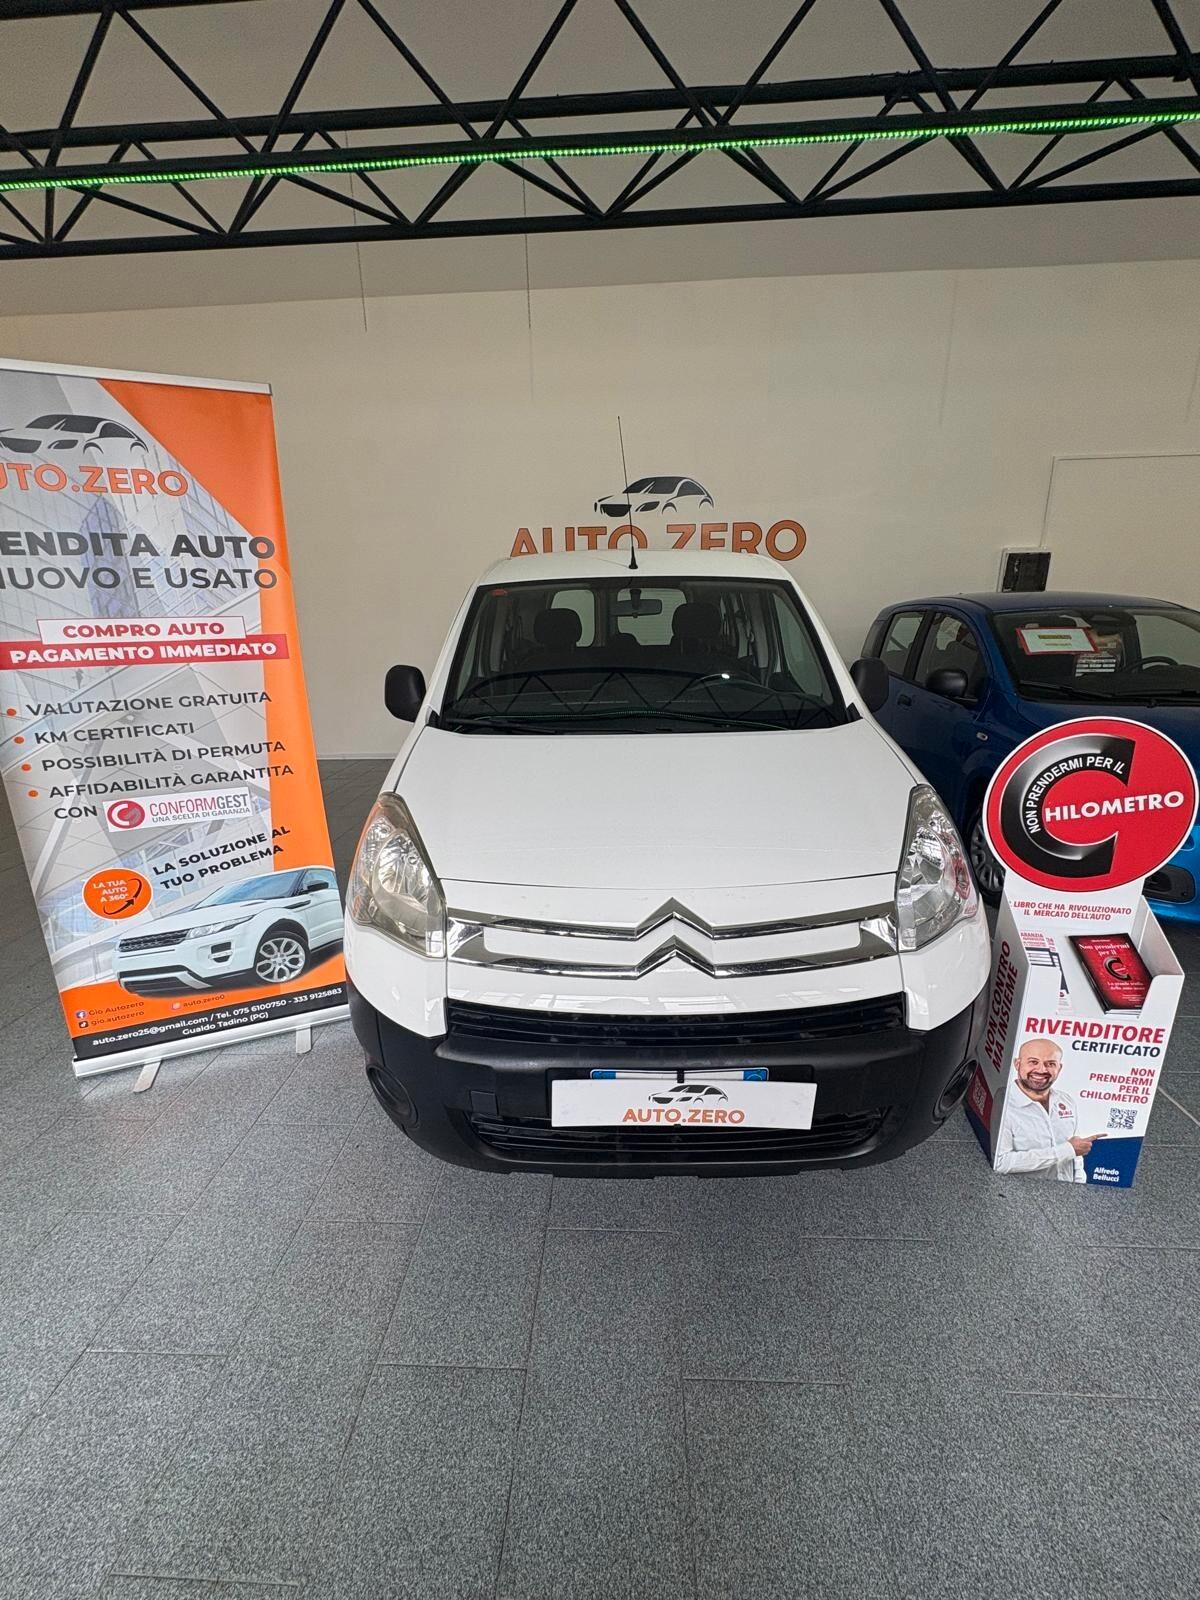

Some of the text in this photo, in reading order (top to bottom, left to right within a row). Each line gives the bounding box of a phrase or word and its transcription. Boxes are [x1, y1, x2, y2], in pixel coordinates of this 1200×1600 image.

[170, 534, 276, 559] AUTO
[0, 566, 278, 590] UOVO E USATO
[63, 622, 225, 638] COMPRO AUTO
[9, 642, 277, 664] PAGAMENTO IMMEDIATO
[26, 691, 273, 717] VALUTAZIONE GRATUITA
[34, 722, 195, 745] KM CERTIFICATI
[42, 741, 286, 772] POSSIBILITÀ DI PERMUTA
[49, 764, 294, 799] AFFIDABILITÀ GARANTITA
[1025, 756, 1125, 834] NON PRENDERMI PER IL
[54, 805, 98, 819] CON
[150, 793, 249, 817] CONFORMGEST
[152, 807, 251, 823] UNA SCELTA DI GARANZIA
[152, 826, 291, 876] LA SOLUZIONE AL
[160, 844, 284, 890] TUO PROBLEMA
[93, 881, 107, 889] LA
[102, 886, 127, 895] AUTO
[1013, 901, 1132, 915] LIBRO CHE HA RIVOLUZIONATO
[1033, 910, 1070, 919] MERCATO
[985, 940, 1011, 1059] NON CONTRO
[216, 1011, 231, 1019] Tel.
[233, 1007, 250, 1016] 075
[251, 1000, 287, 1012] 6100750
[992, 963, 1019, 1073] MA INSIEME
[182, 1024, 216, 1035] Gualdo
[218, 1017, 248, 1028] Tadino
[1025, 1017, 1166, 1044] RIVENDITORE
[1072, 1040, 1161, 1058] CERTIFICATO
[1089, 1073, 1153, 1087] PRENDERMI
[1130, 1067, 1155, 1078] NON
[1080, 1089, 1149, 1104] CHILOMETRO
[1119, 1085, 1151, 1096] PER IL
[622, 1108, 745, 1124] AUTO.ZERO
[1093, 1174, 1120, 1182] Bellucci
[1094, 1167, 1119, 1176] Alfredo
